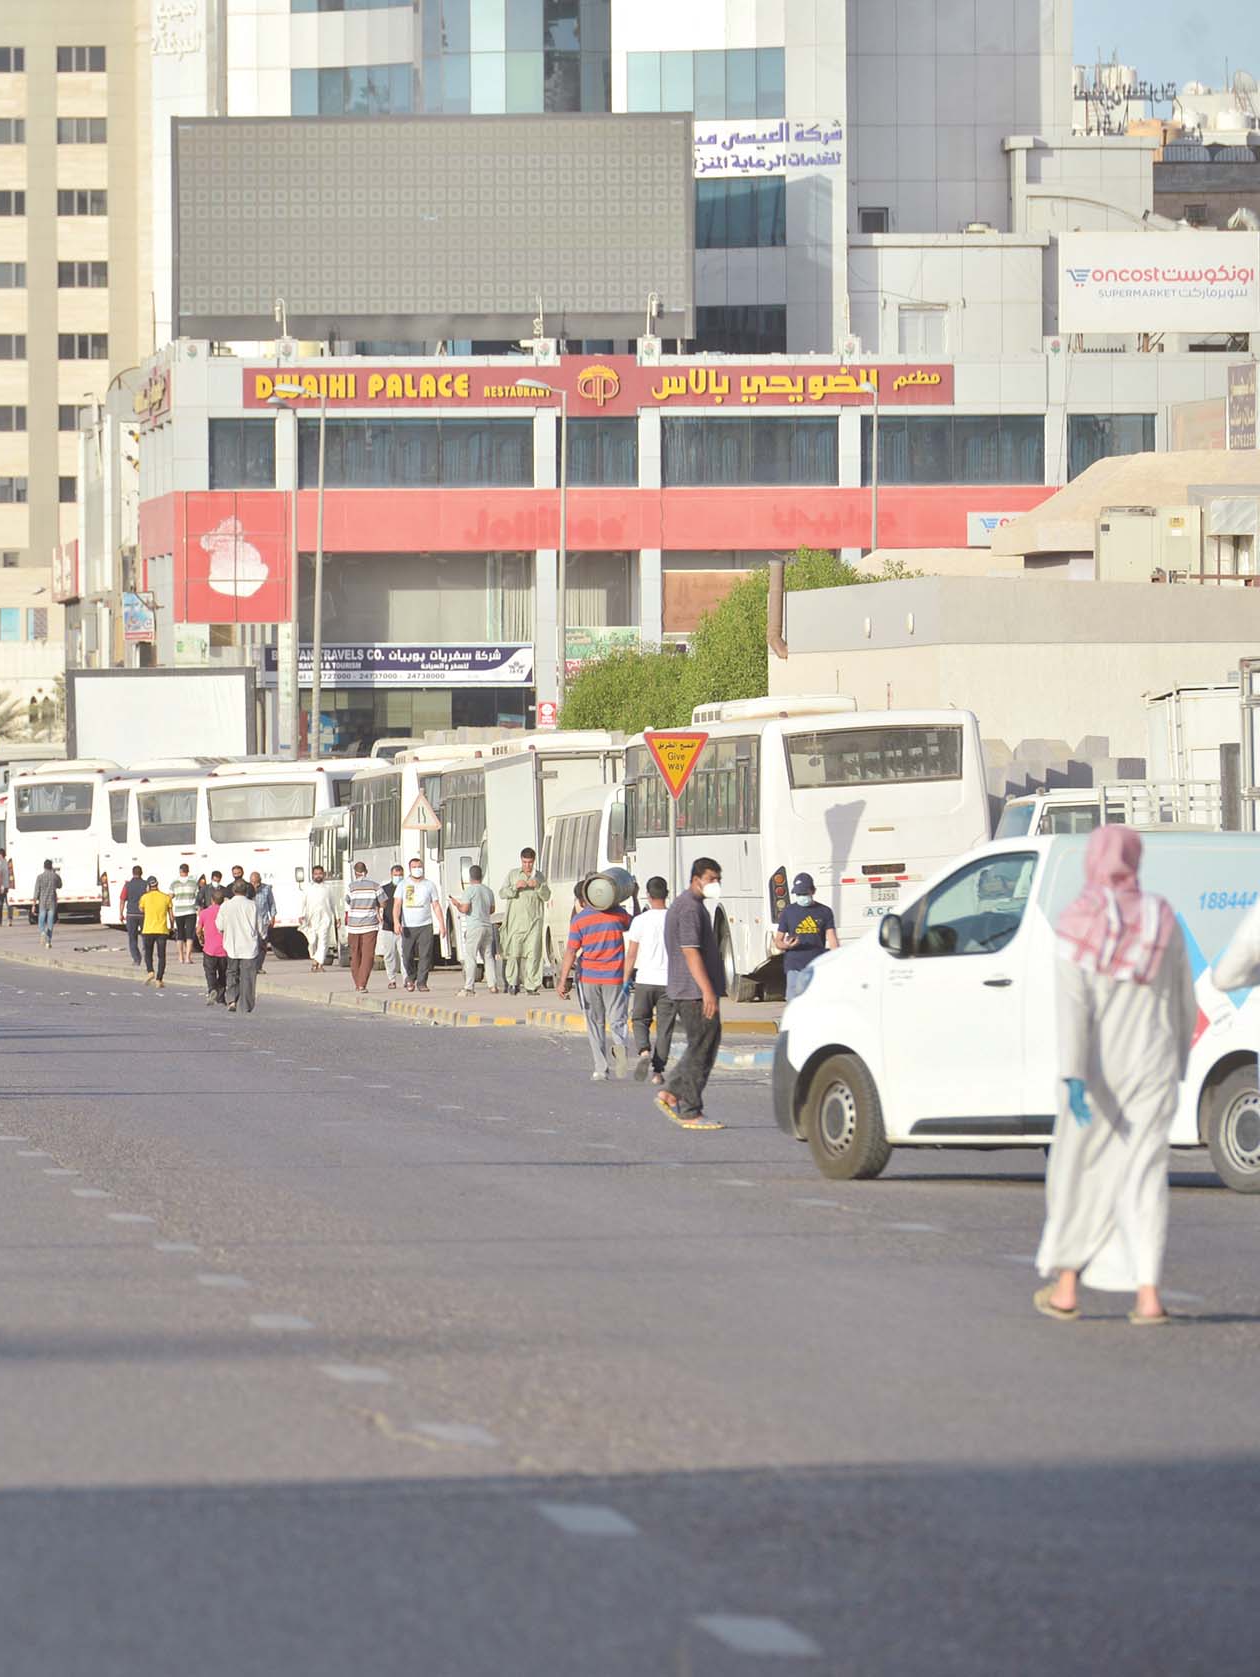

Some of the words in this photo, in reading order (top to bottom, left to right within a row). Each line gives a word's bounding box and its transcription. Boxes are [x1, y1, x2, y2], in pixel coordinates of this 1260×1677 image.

[721, 121, 790, 150] العيسى
[794, 120, 843, 145] شركة
[694, 156, 728, 173] المنز
[731, 154, 787, 173] الرعاية
[1092, 267, 1160, 282] oncost
[1098, 288, 1176, 298] SUPERMARKET
[368, 373, 470, 399] PALACE
[651, 367, 730, 404] بالاس
[741, 366, 878, 403] الضويحي
[893, 369, 941, 391] مطعم
[367, 648, 385, 661] CO.
[388, 648, 426, 662] بوبيان
[429, 649, 472, 662] سفريات
[475, 648, 502, 662] شركة
[667, 751, 686, 761] Give
[667, 763, 685, 772] way
